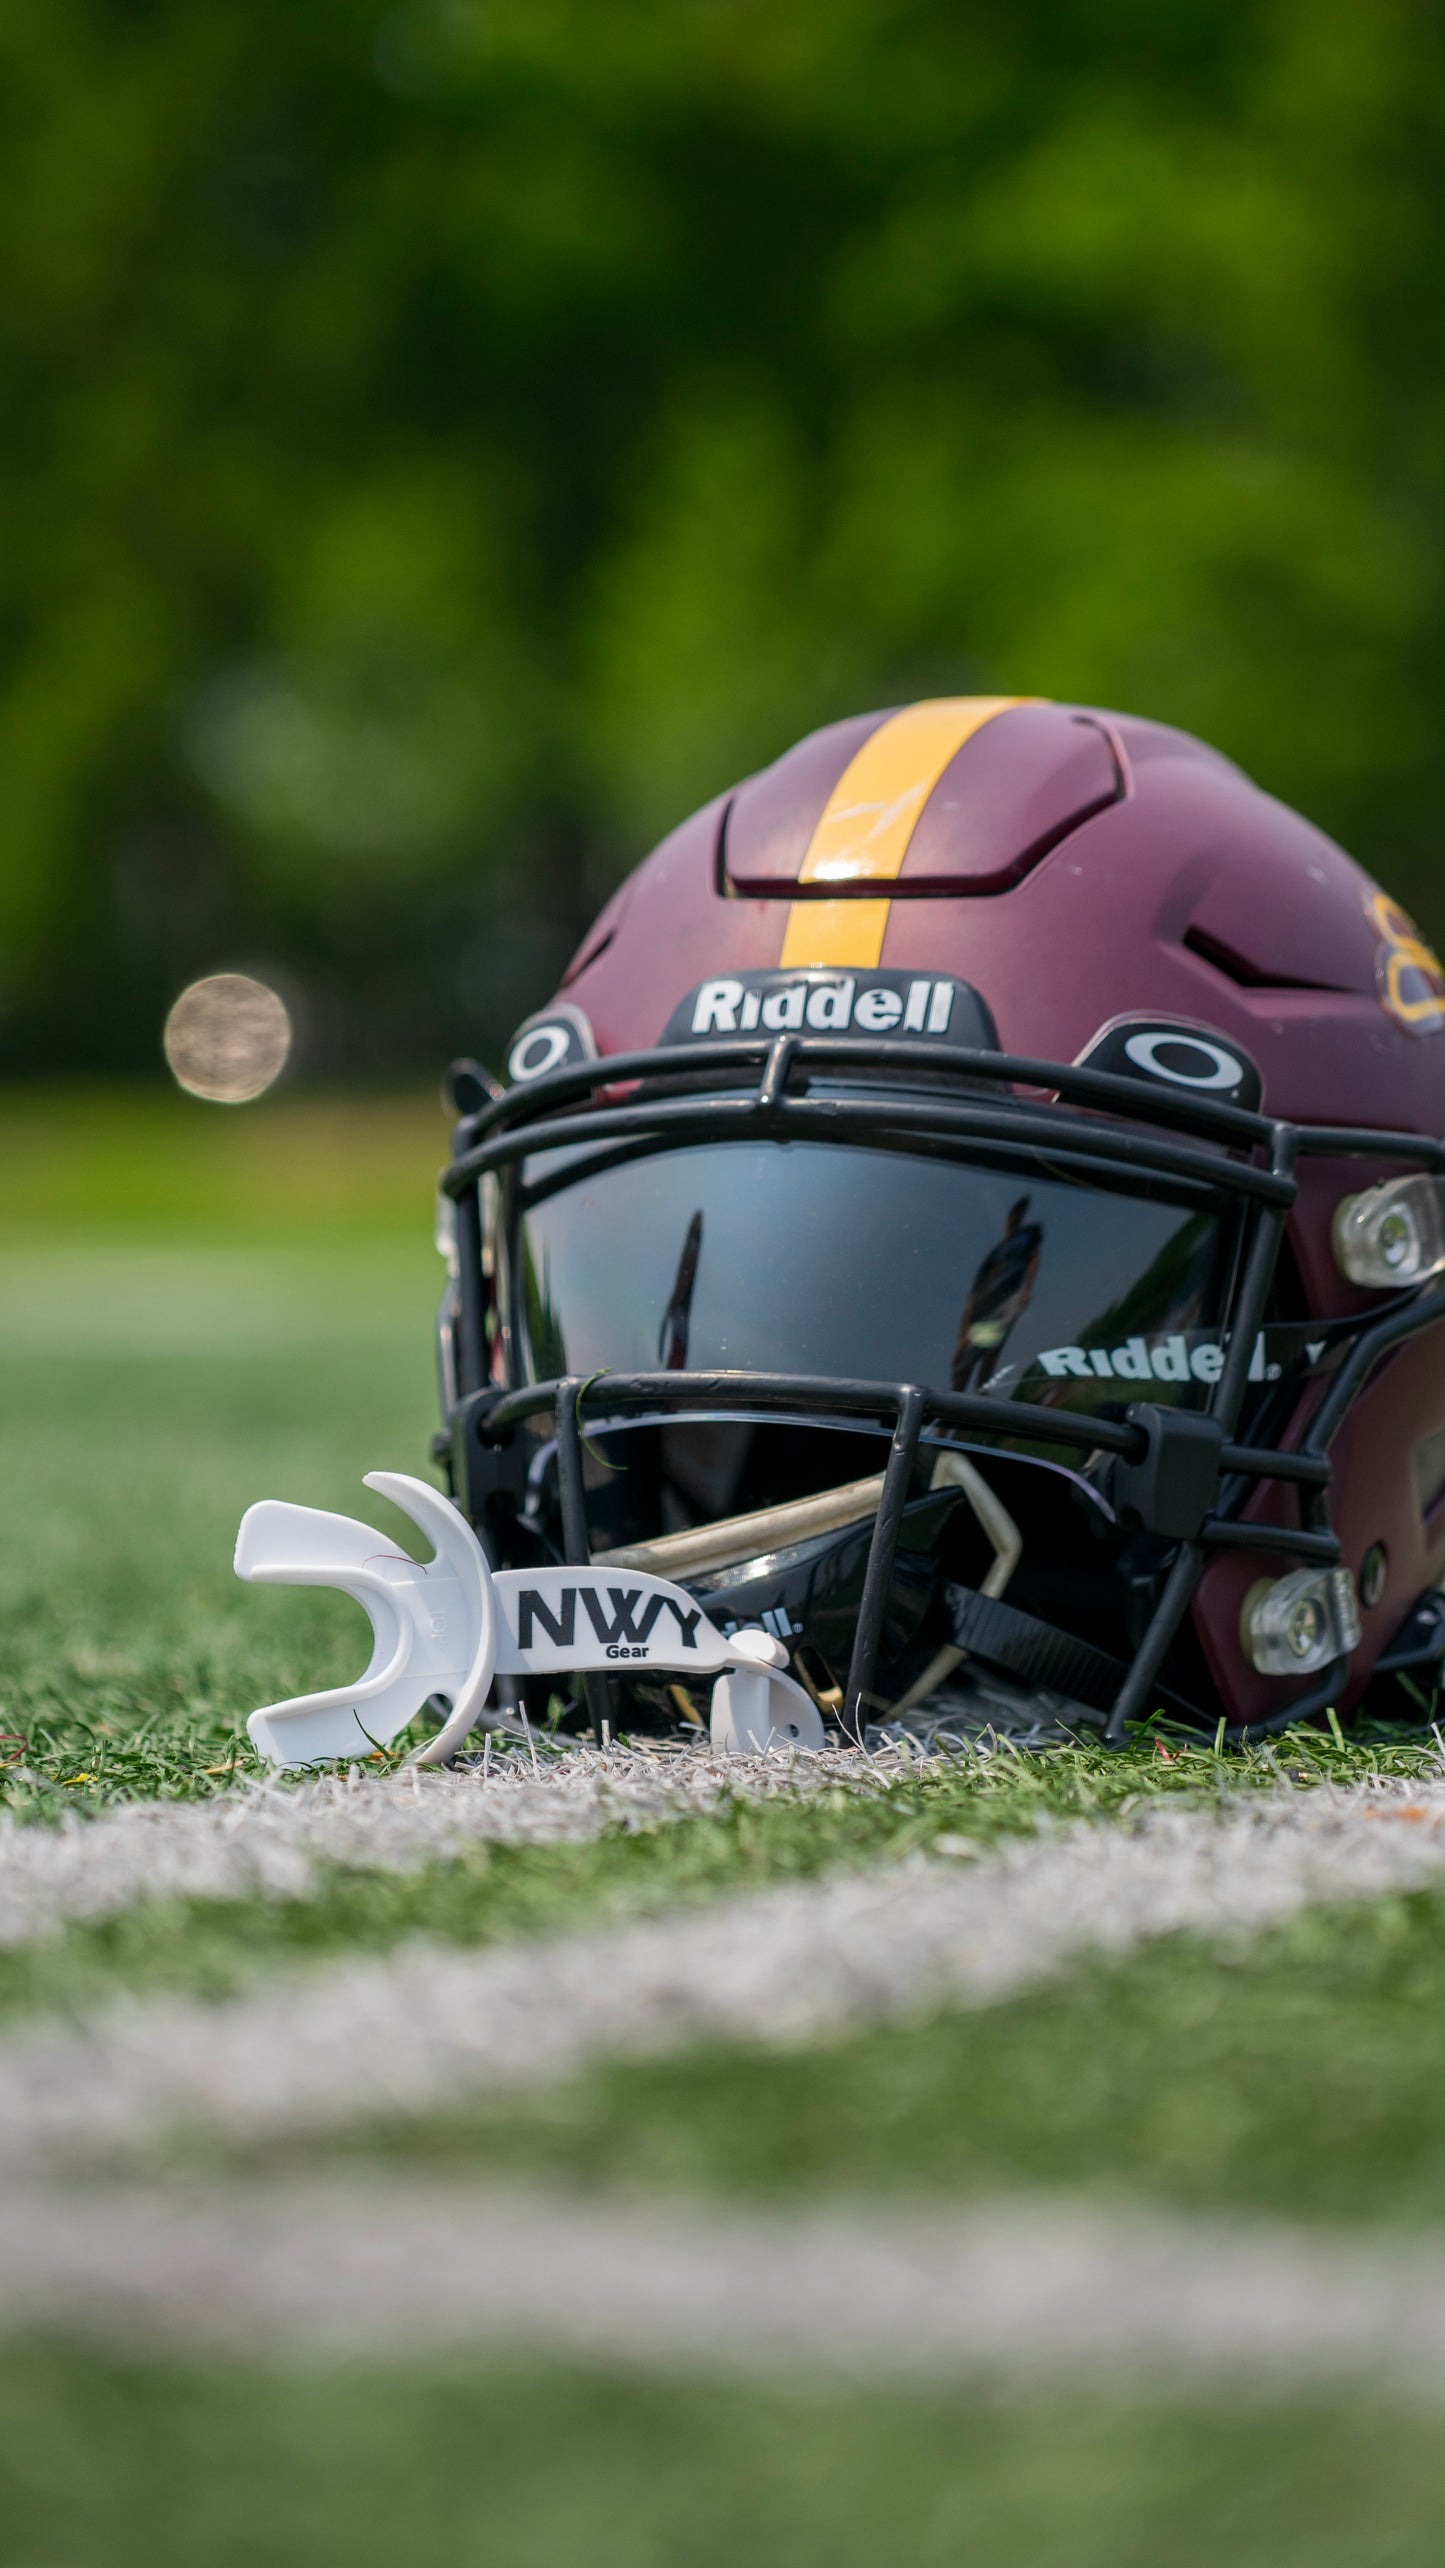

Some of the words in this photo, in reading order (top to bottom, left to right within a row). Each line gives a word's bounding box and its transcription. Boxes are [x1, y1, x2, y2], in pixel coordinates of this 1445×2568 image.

[691, 977, 956, 1035] Riddell
[1037, 1330, 1266, 1384] Riddel
[518, 1587, 702, 1650] NWY
[605, 1644, 650, 1660] Gear
